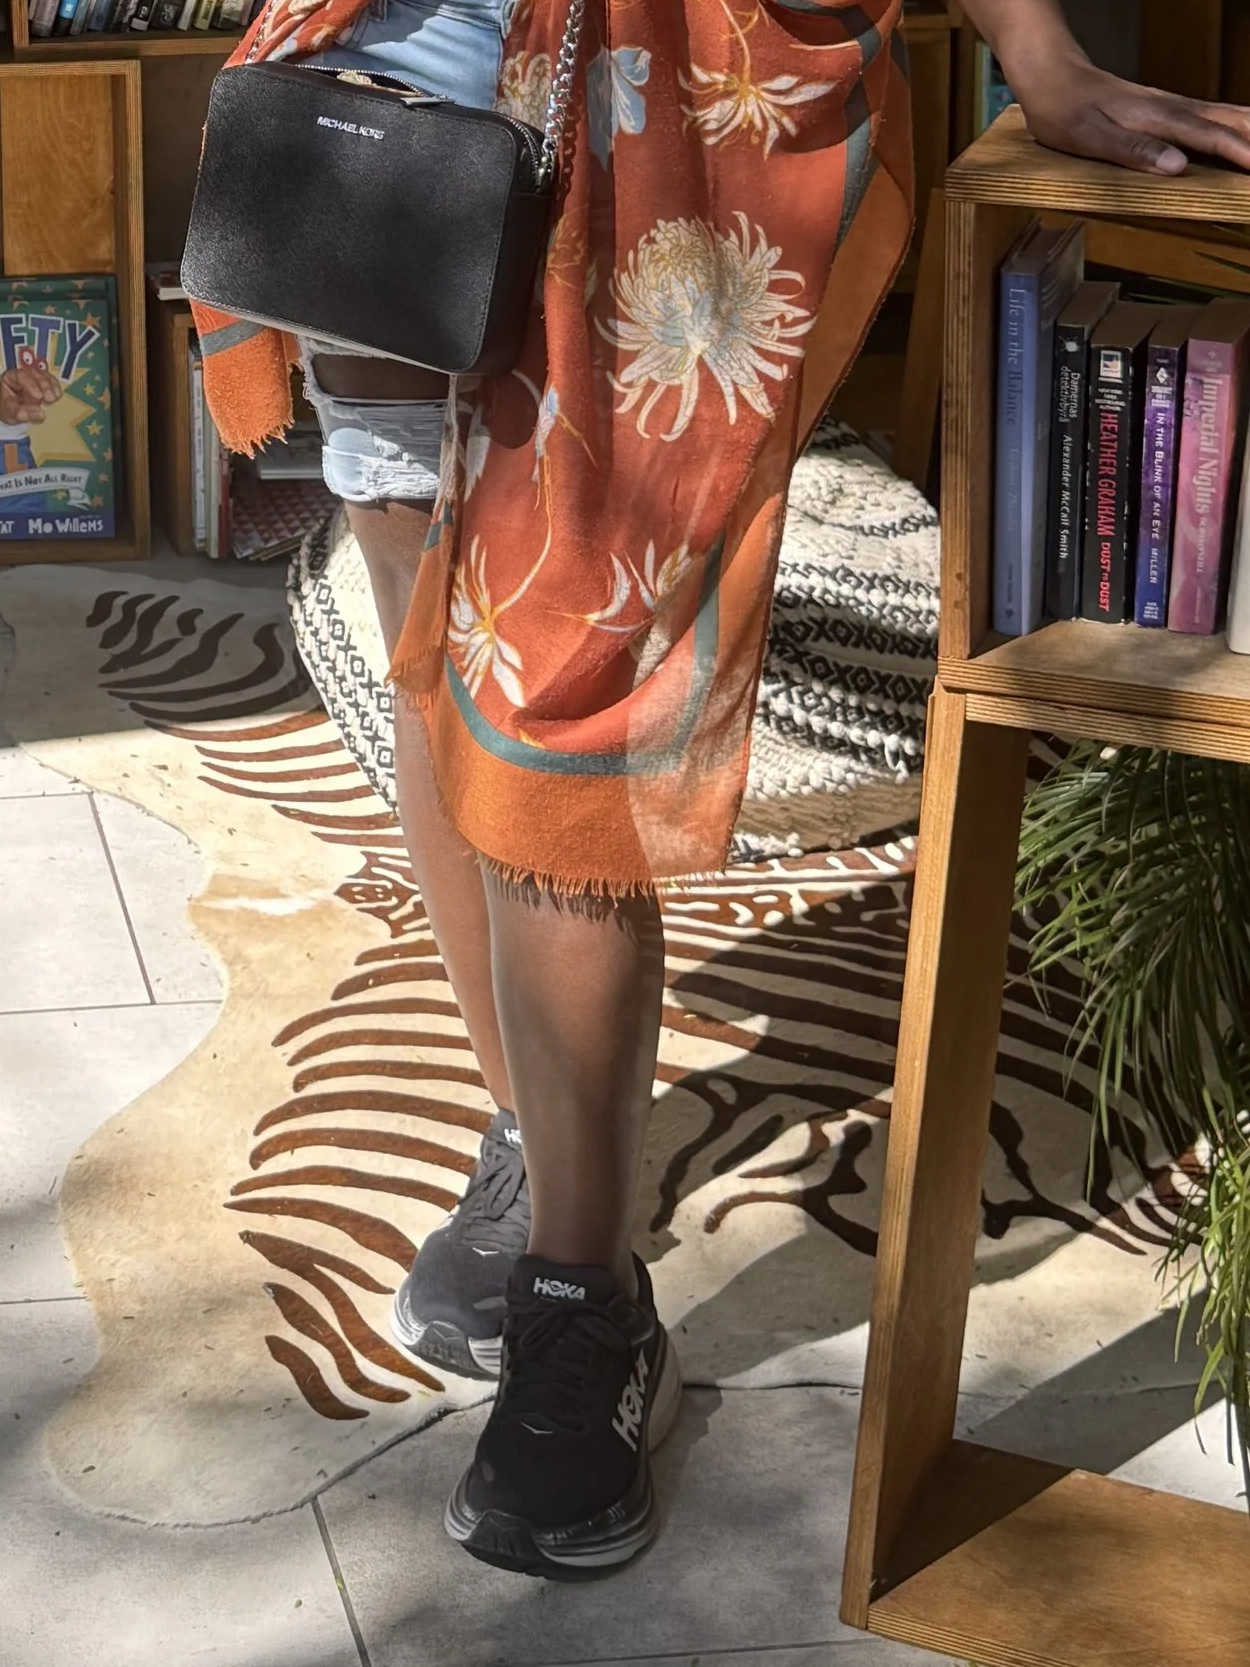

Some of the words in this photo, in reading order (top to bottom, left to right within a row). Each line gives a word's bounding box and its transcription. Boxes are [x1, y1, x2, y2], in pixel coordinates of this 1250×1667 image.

[317, 116, 358, 133] MICHAEL
[359, 126, 385, 140] KORS
[1008, 287, 1026, 316] Life
[1007, 321, 1025, 337] in
[1006, 341, 1024, 365] the
[1003, 369, 1023, 426] Balance
[1068, 371, 1081, 419] Damernas
[1156, 412, 1167, 426] IN
[1194, 376, 1224, 455] Imperial
[1098, 412, 1120, 476] HEATHER
[1155, 426, 1166, 447] THE
[1060, 434, 1073, 488] Alexander
[1153, 450, 1165, 484] BLINK
[14, 477, 23, 488] IS
[25, 475, 42, 486] NOT
[1152, 484, 1163, 498] OF
[1189, 456, 1219, 515] Nights
[1059, 489, 1071, 527] McCall
[1095, 478, 1117, 537] GRAHAM
[1151, 500, 1162, 517] AN
[1057, 528, 1070, 560] Smith
[1150, 519, 1161, 540] EYE
[1099, 541, 1113, 572] DUST
[1148, 547, 1159, 585] MILLER
[1097, 580, 1111, 612] DUST
[533, 1277, 586, 1300] HOKA
[612, 1346, 648, 1452] HOKA
